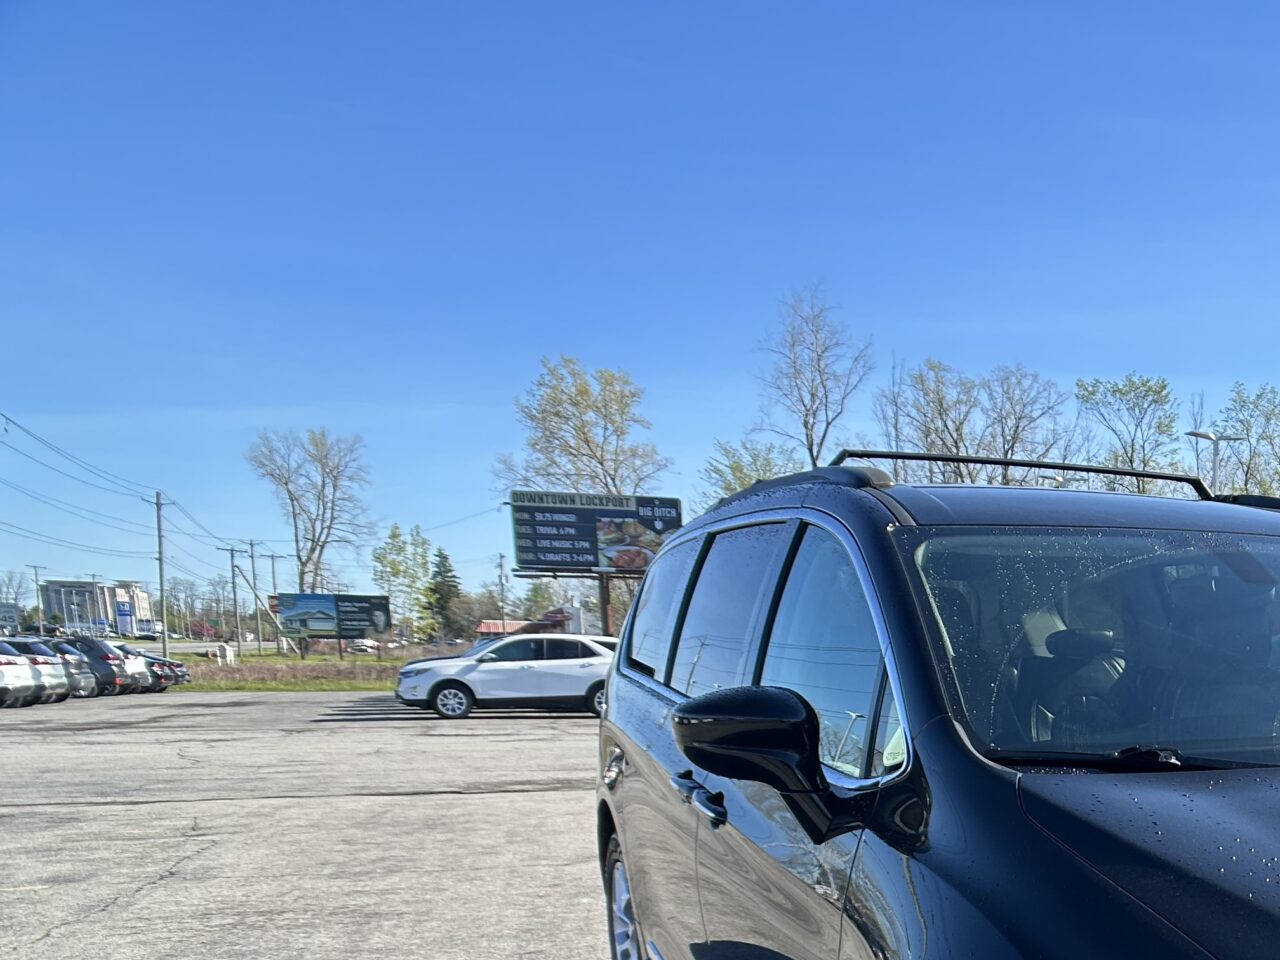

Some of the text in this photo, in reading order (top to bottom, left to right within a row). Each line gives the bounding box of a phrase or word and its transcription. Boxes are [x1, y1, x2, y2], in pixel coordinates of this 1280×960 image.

[513, 491, 630, 508] DOWNTOWN LOCKPORT
[639, 506, 676, 517] BIG DITCH
